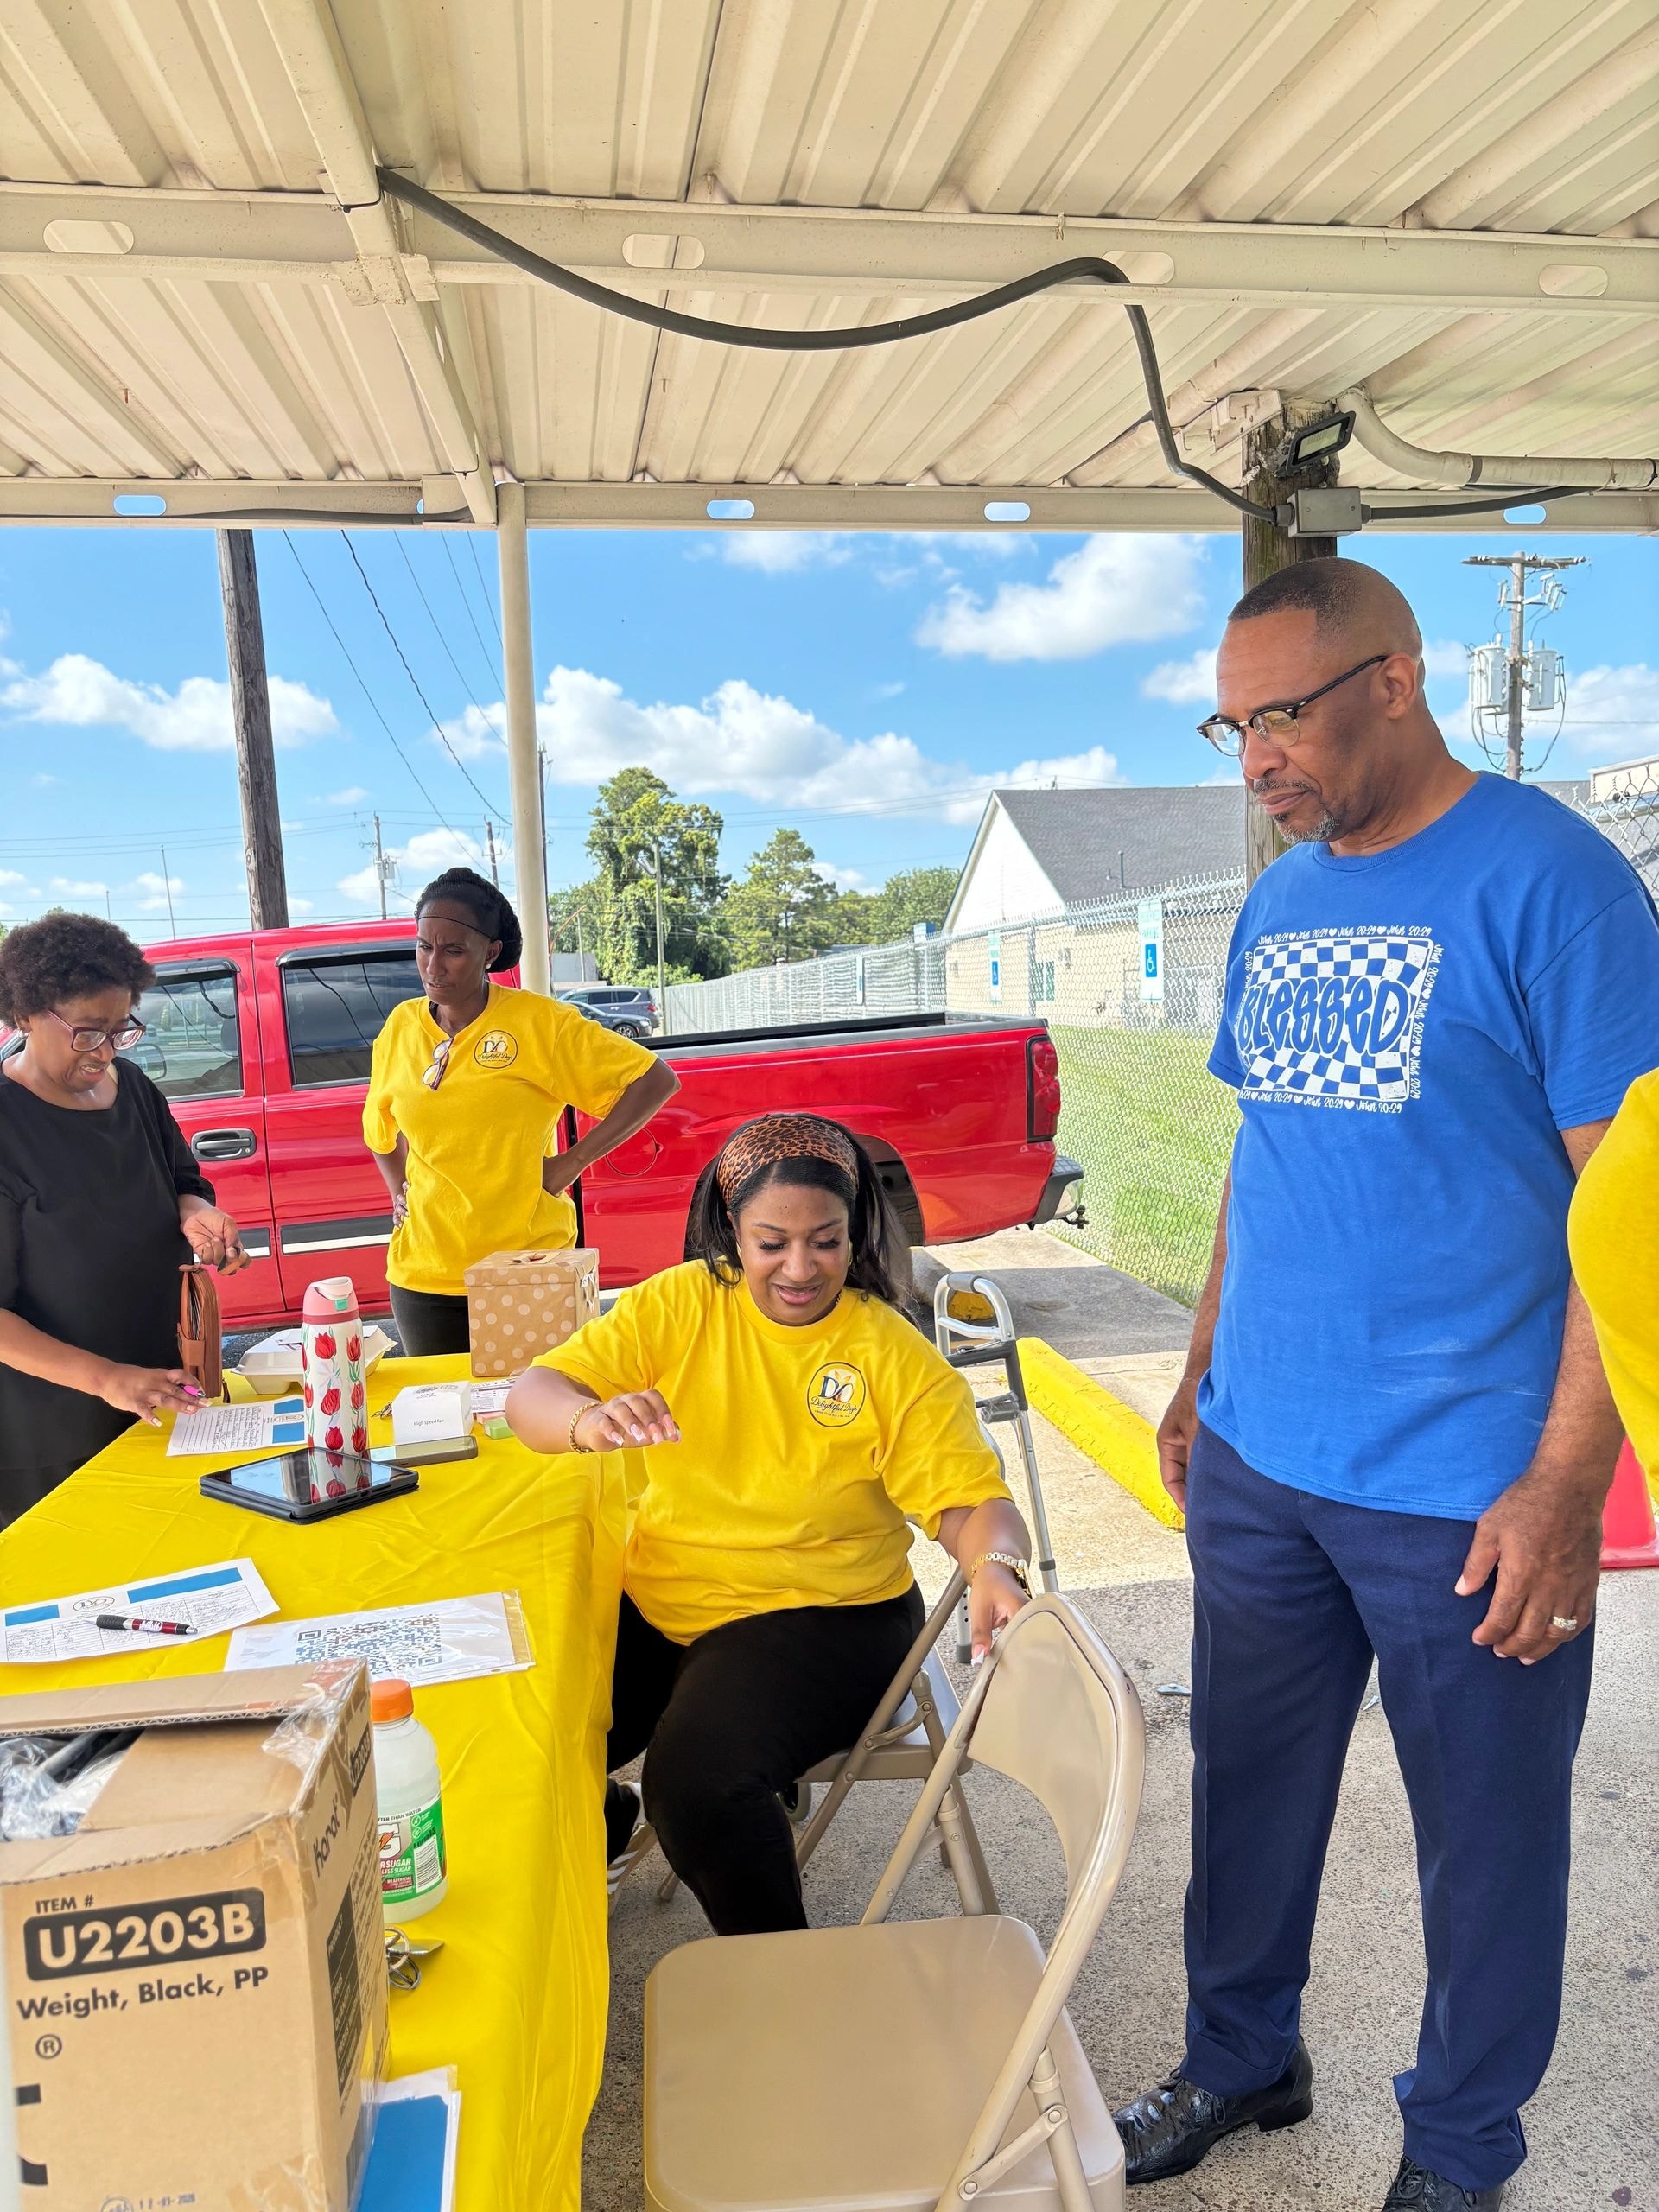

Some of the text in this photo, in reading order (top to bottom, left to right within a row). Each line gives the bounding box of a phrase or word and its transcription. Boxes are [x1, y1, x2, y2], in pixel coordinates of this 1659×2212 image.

[1408, 925, 1432, 937] 20:29
[1379, 1102, 1402, 1114] 20:29
[405, 1808, 422, 1817] WATER
[385, 1859, 411, 1868] SUGAR
[35, 1894, 93, 1914] ITEM #
[39, 1903, 254, 1968] U2203B
[17, 1966, 268, 2019] Weight, Black, PP
